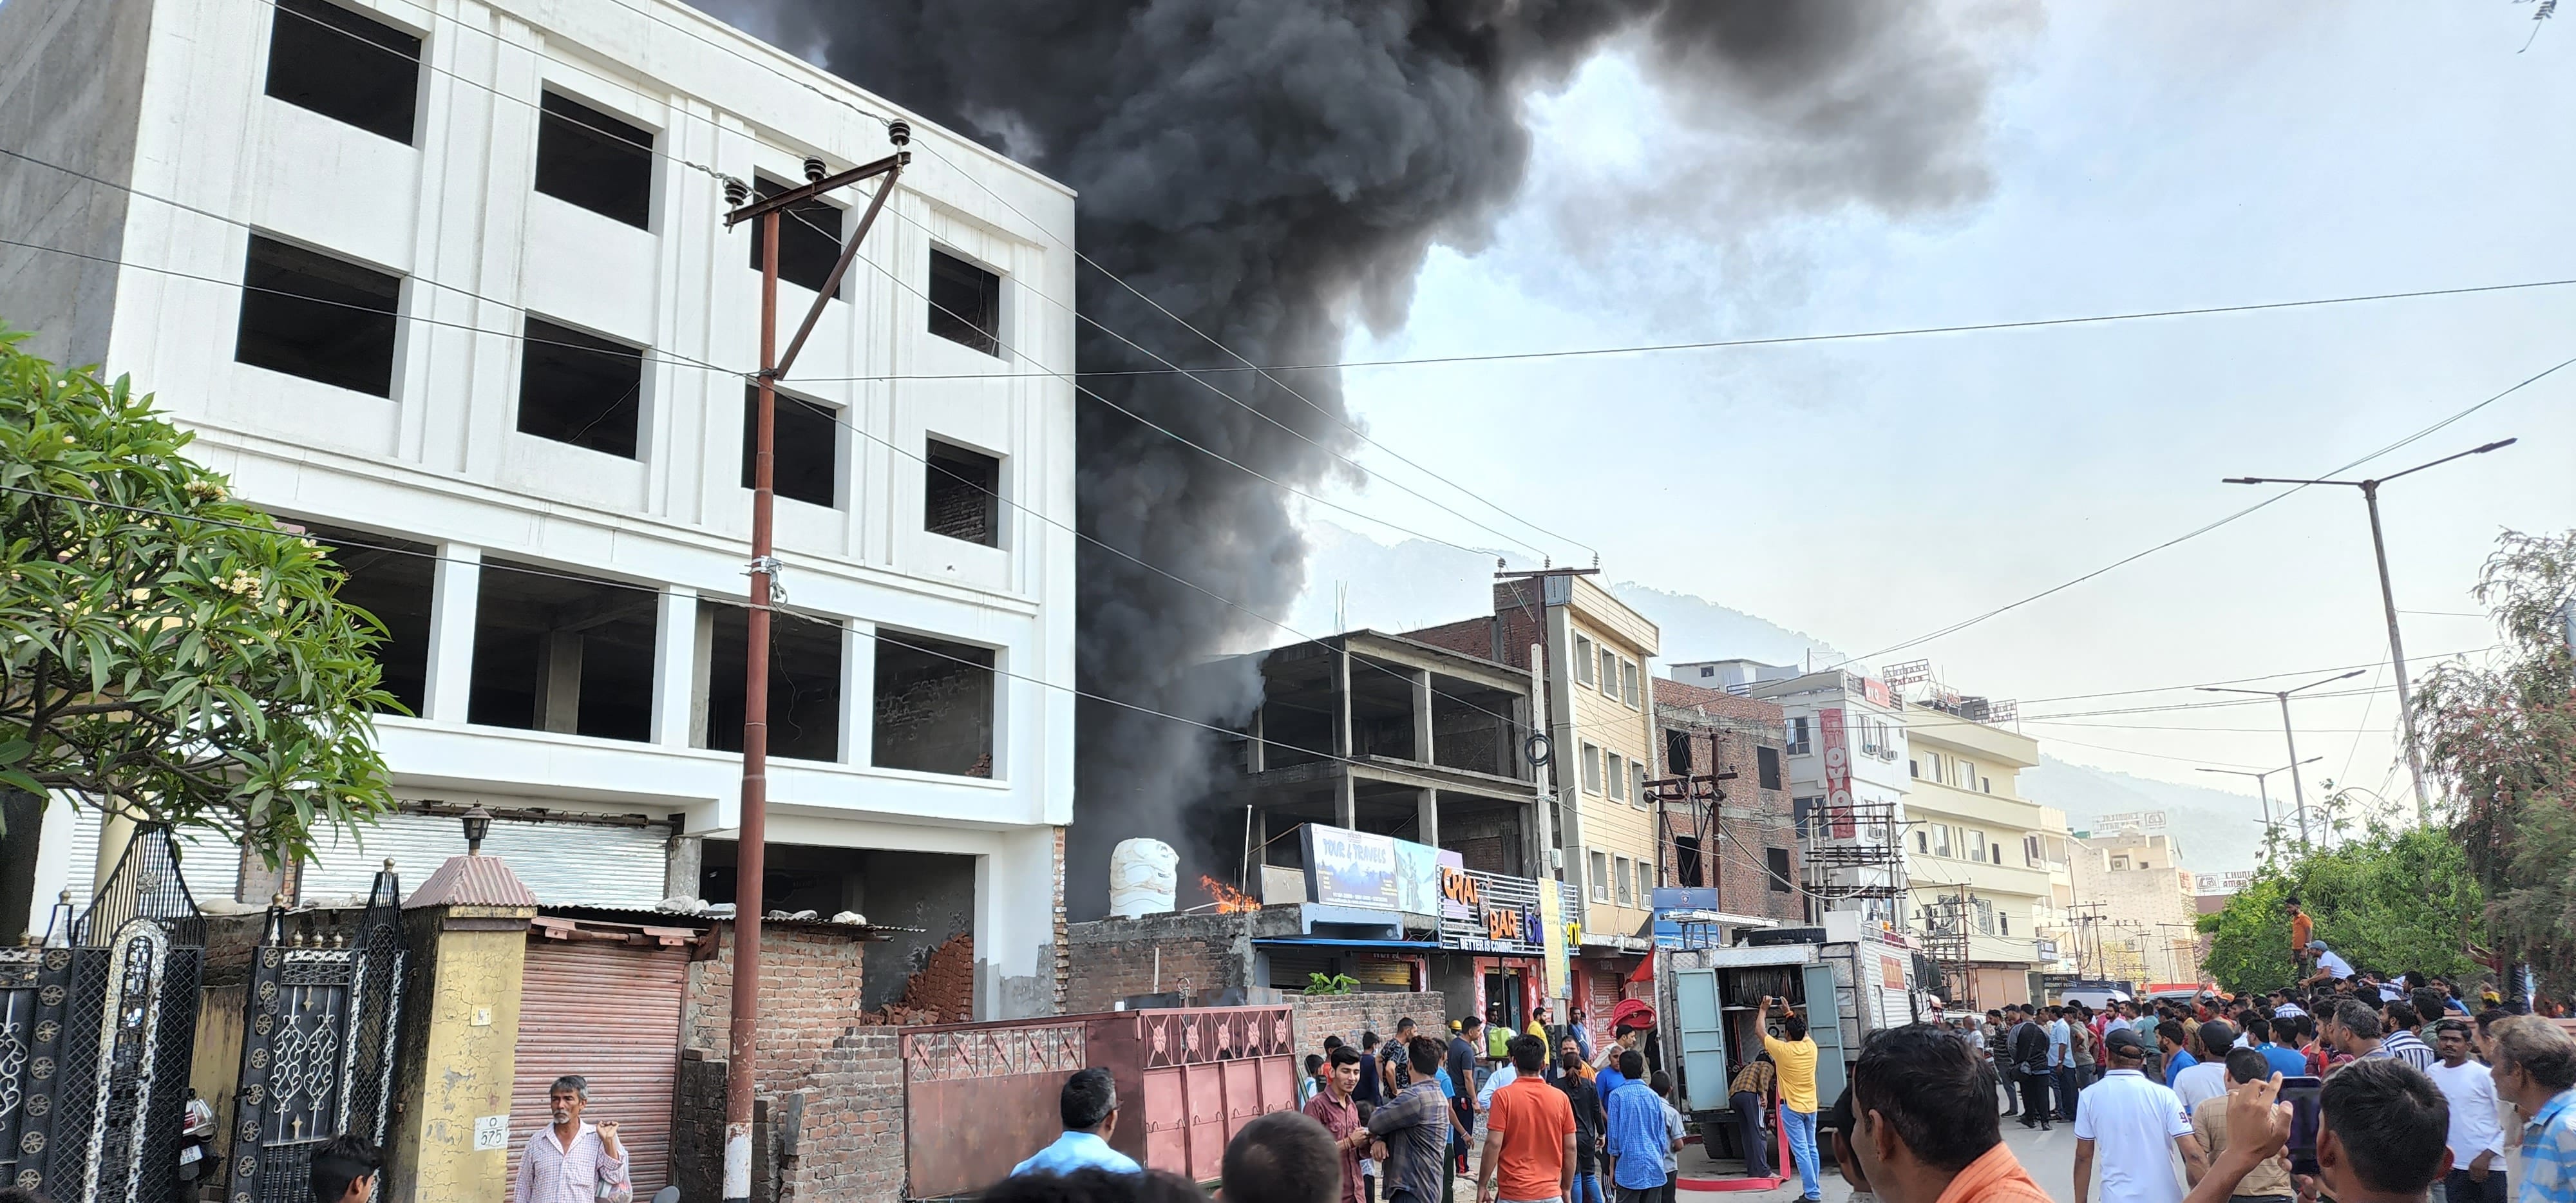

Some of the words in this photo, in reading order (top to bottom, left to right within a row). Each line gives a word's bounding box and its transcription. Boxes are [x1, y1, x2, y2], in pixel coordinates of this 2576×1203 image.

[1323, 838, 1345, 858] TOUR
[1352, 844, 1387, 864] TRAVELS
[1442, 867, 1479, 905] CHAI
[1488, 908, 1518, 940] BAR
[1459, 938, 1484, 951] BETTER
[1484, 940, 1490, 951] IS
[1491, 941, 1513, 953] COMING
[481, 1129, 503, 1145] 575
